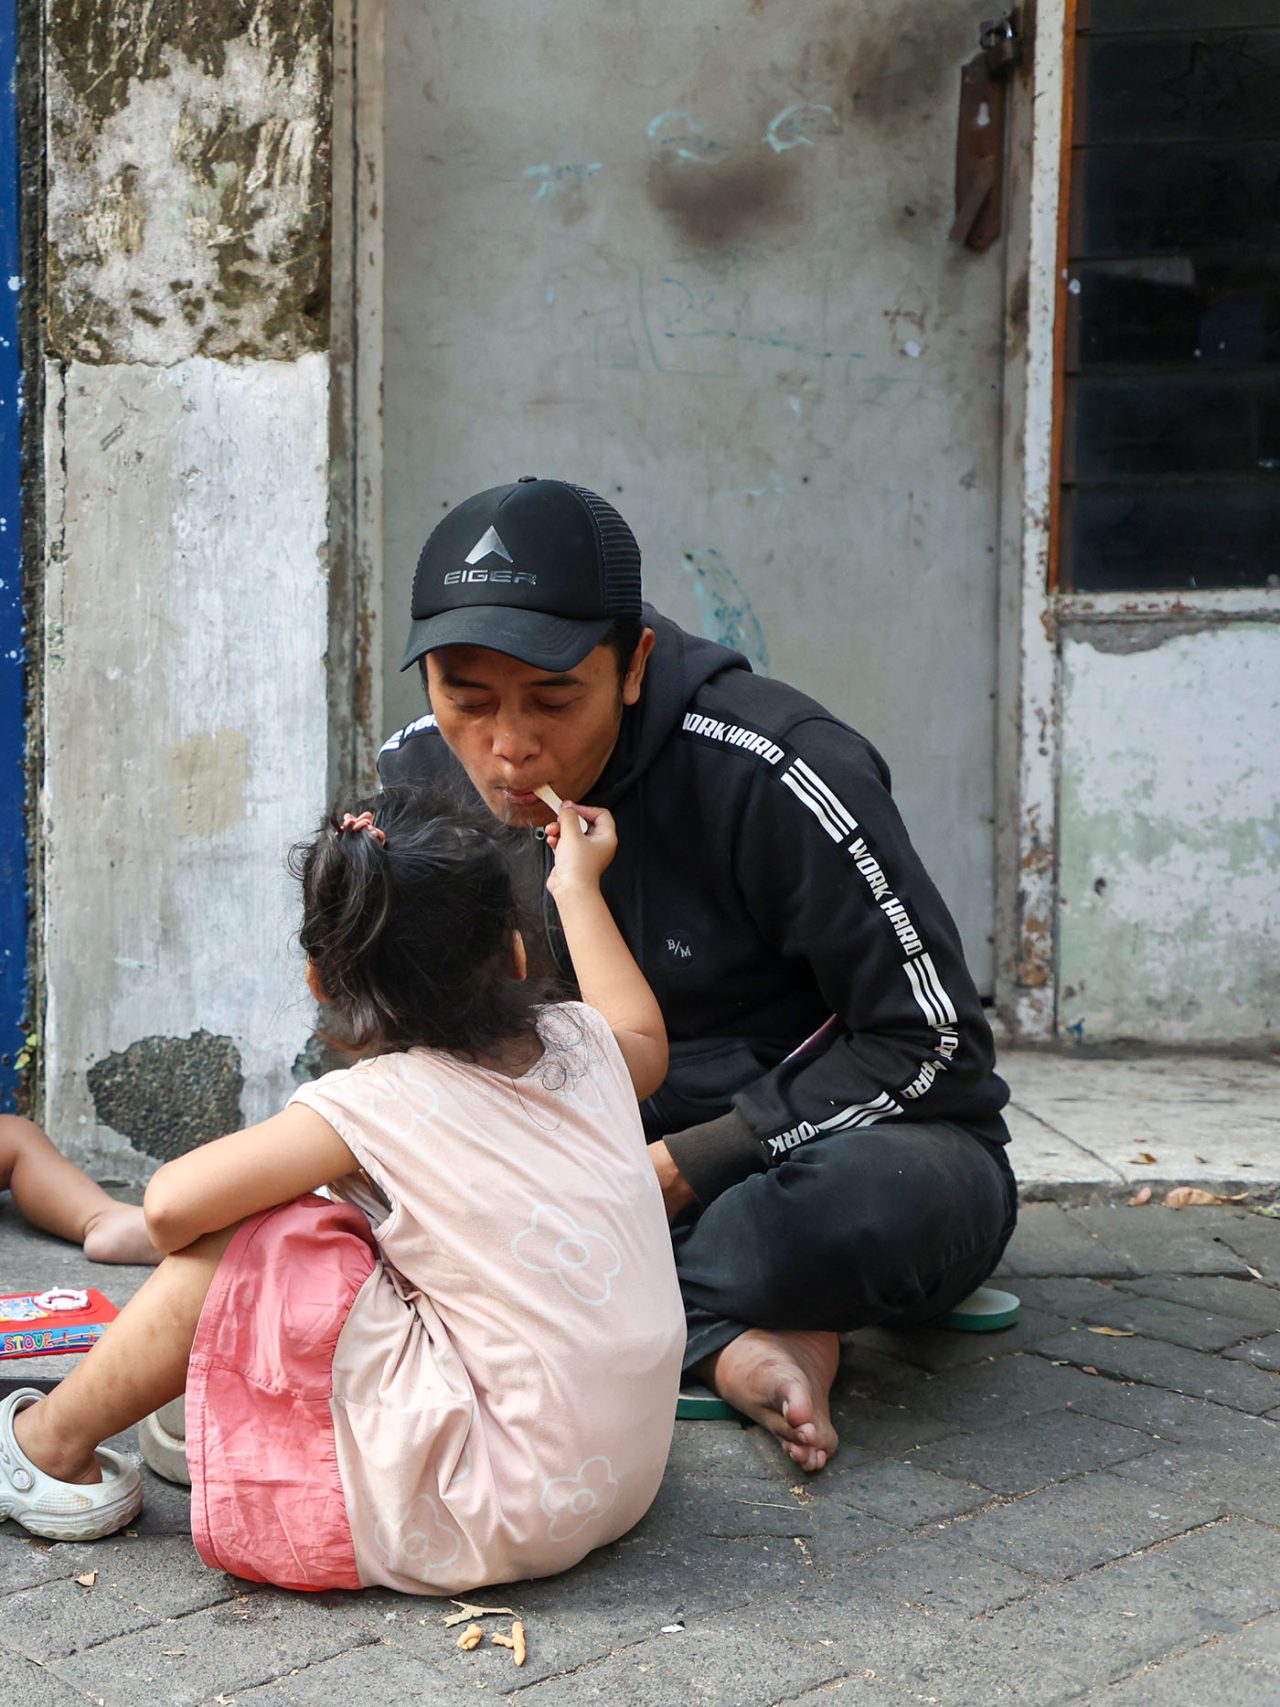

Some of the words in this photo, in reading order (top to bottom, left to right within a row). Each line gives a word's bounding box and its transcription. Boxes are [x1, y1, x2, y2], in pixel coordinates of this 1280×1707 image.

[444, 570, 536, 585] EIGER
[724, 725, 786, 766] HARD
[847, 836, 894, 902] WORK
[879, 896, 924, 957] HARD
[767, 1120, 820, 1157] ORK
[4, 1332, 53, 1351] STOVE
